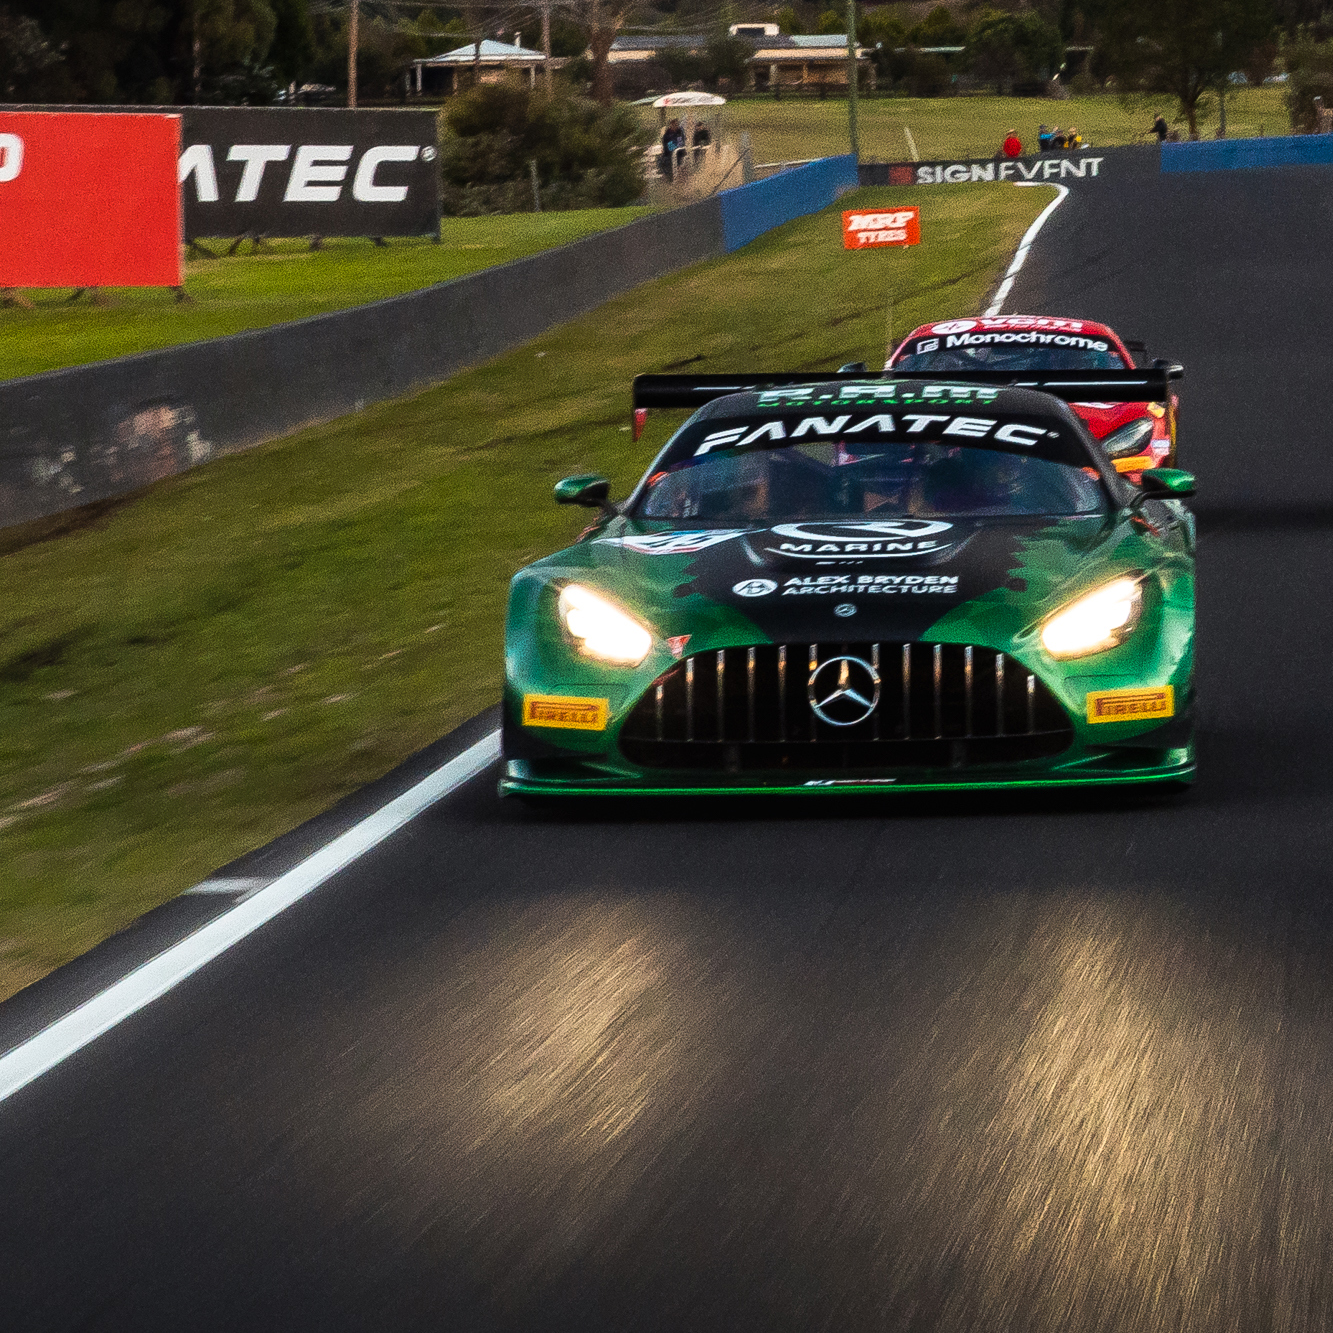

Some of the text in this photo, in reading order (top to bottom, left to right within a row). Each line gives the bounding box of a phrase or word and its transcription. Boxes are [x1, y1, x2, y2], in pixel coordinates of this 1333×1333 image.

[177, 144, 420, 202] ATEC
[946, 331, 1109, 352] Monochrome
[694, 414, 1048, 457] FANATEC
[780, 540, 938, 553] MARINE
[781, 584, 958, 596] ARCHITECTURE
[783, 574, 959, 586] ALEX BRYDEN
[1094, 692, 1167, 717] PIRELLI
